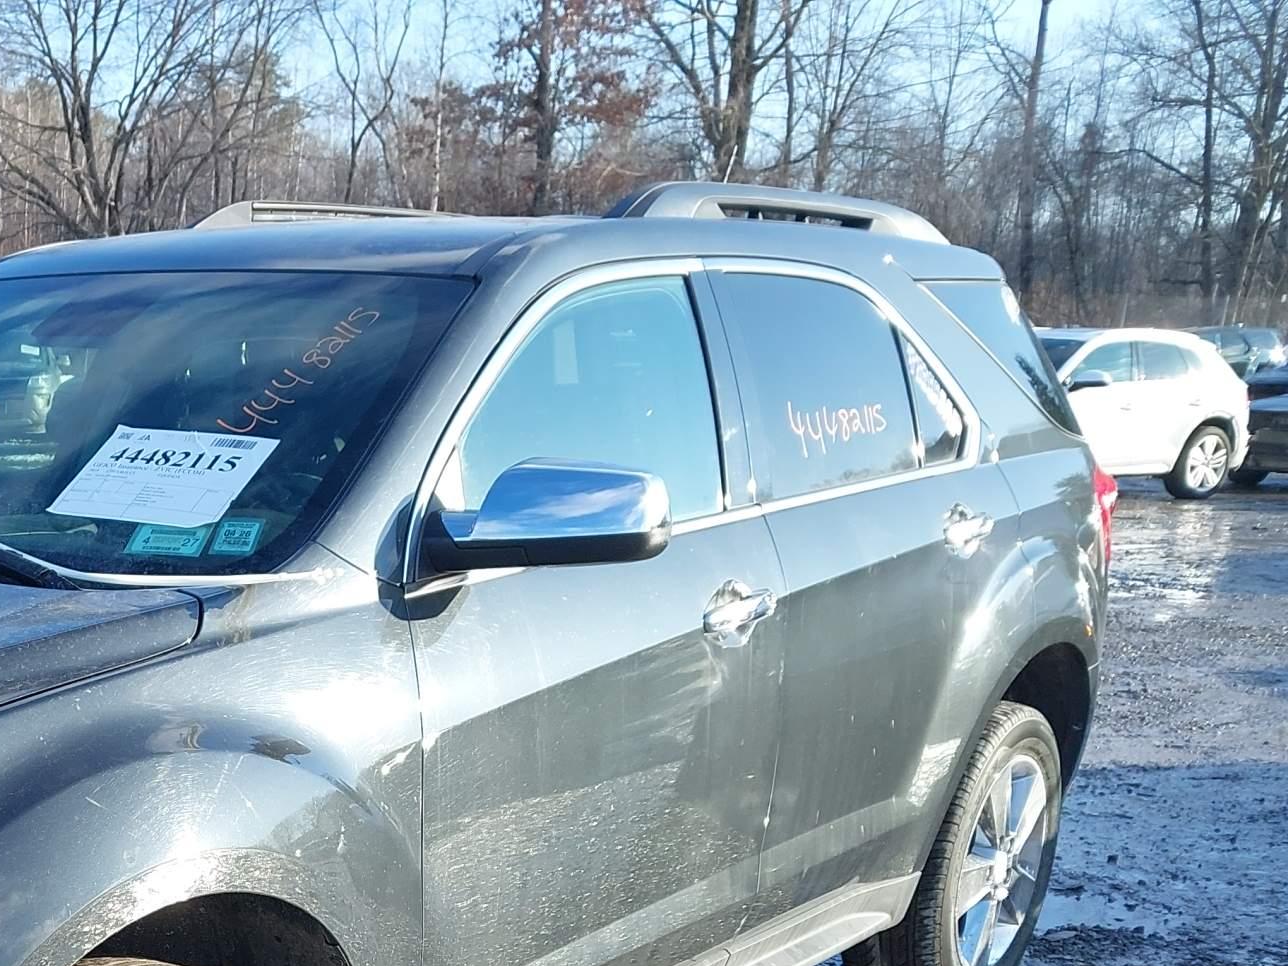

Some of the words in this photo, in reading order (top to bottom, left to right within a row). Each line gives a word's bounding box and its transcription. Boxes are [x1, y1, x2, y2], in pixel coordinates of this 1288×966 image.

[787, 400, 888, 458] 44482115
[110, 446, 244, 472] 44482115
[181, 537, 200, 547] 27
